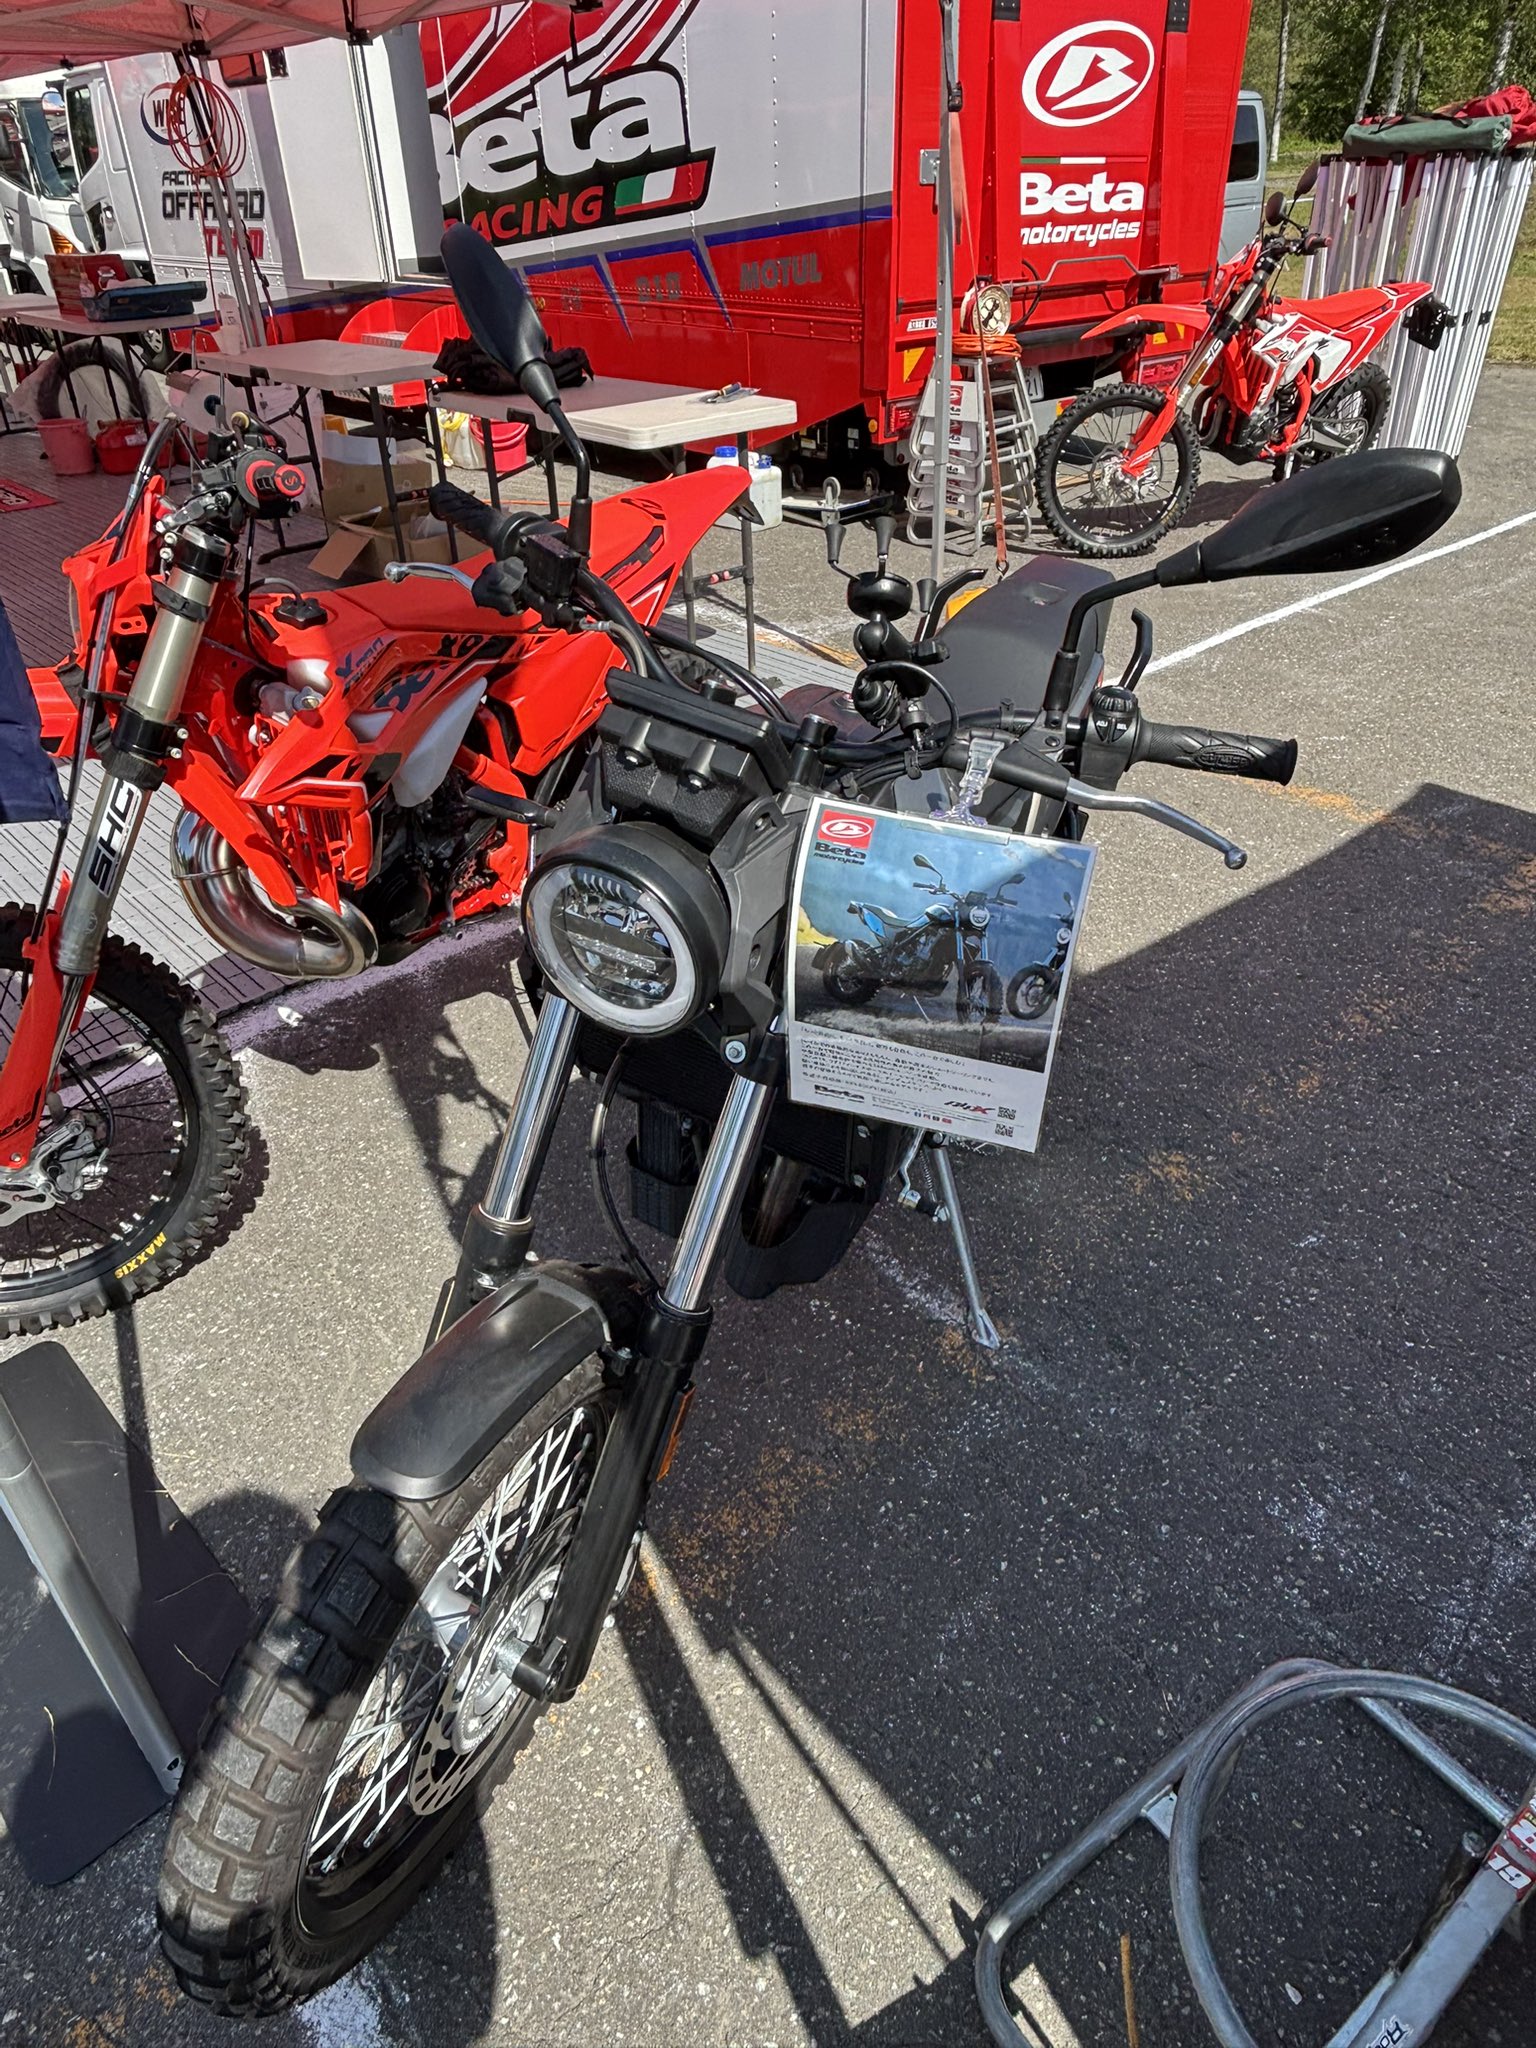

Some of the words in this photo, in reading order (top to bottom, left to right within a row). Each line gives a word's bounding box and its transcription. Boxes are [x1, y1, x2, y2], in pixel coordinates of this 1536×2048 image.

[1020, 171, 1145, 216] Beta
[739, 252, 822, 291] MOTUL
[815, 842, 867, 859] Beta
[114, 1231, 168, 1279] MAXXIS
